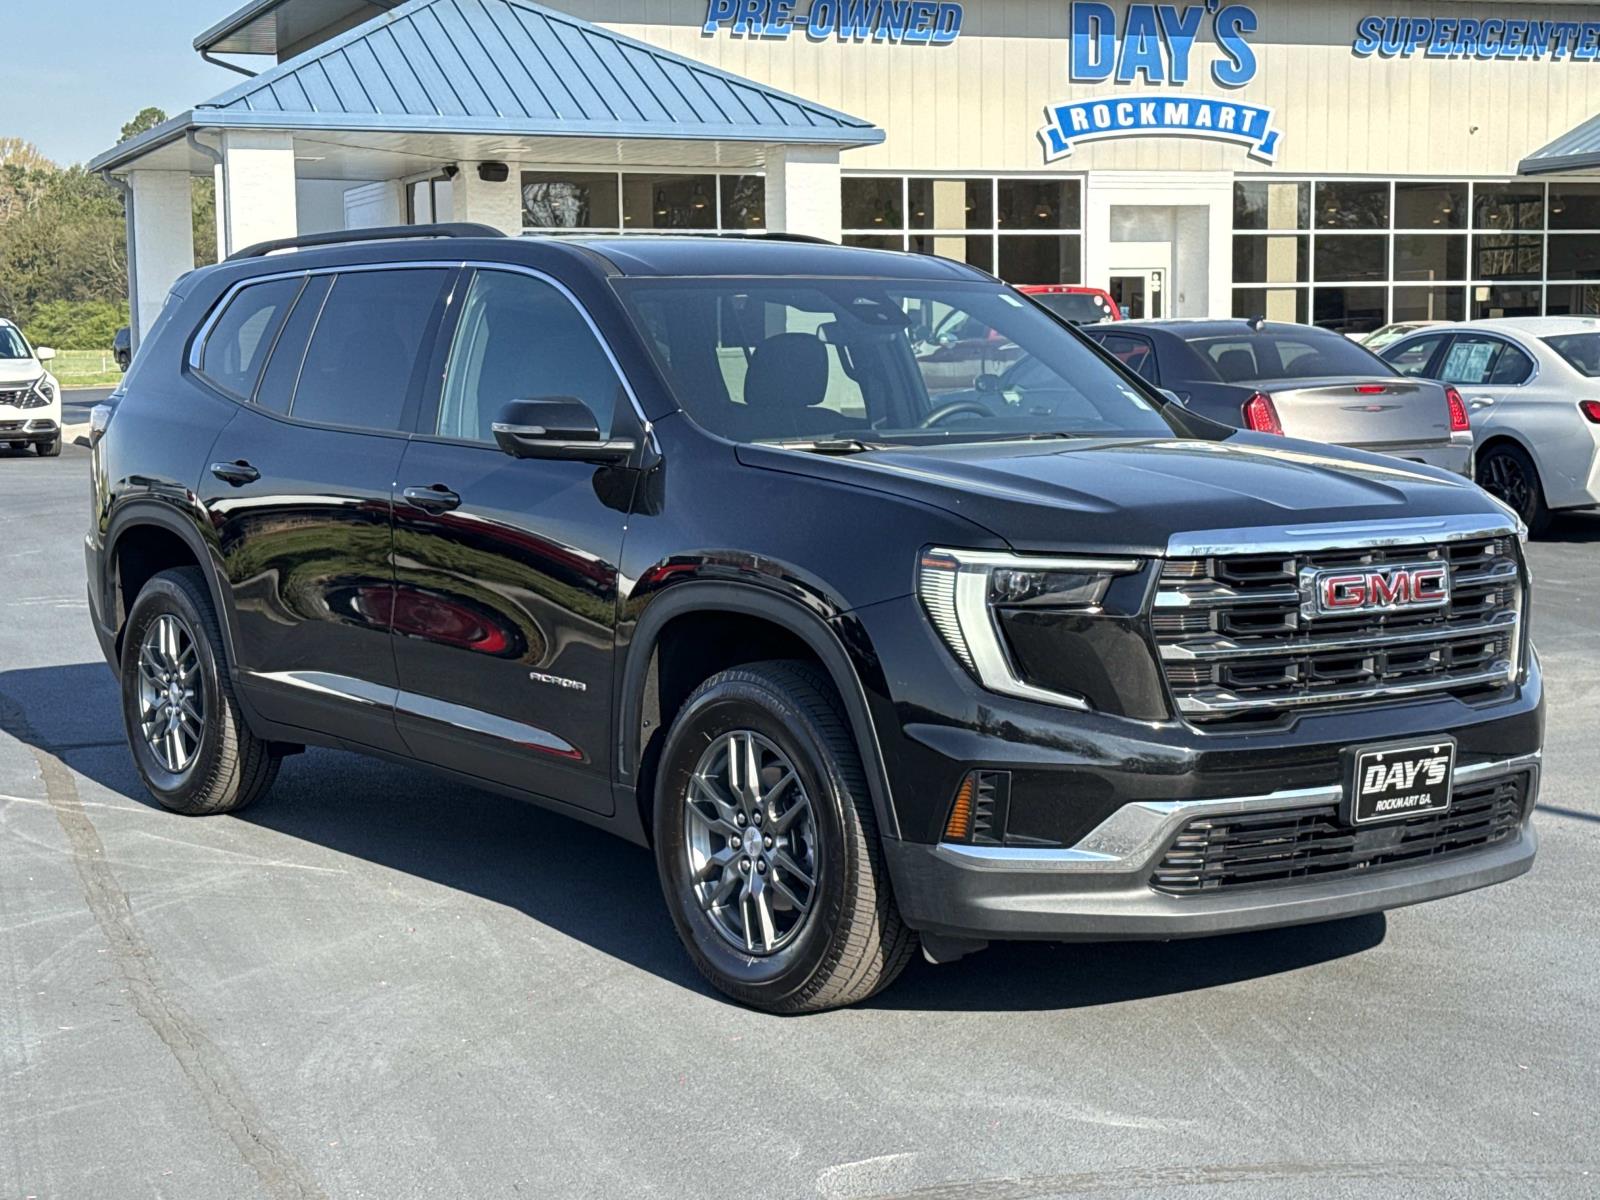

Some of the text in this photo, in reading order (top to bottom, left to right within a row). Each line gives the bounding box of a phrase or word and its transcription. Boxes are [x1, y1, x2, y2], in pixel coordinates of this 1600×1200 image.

[703, 0, 963, 42] PRE-OWNED
[1355, 16, 1600, 58] SUPERCENTE
[1072, 0, 1258, 86] DAY'S
[1070, 102, 1257, 132] ROCKMART
[1322, 568, 1450, 609] GMC
[529, 671, 587, 692] ACADIA
[1361, 755, 1449, 795] DAY'S
[1375, 795, 1419, 812] ROCKMART
